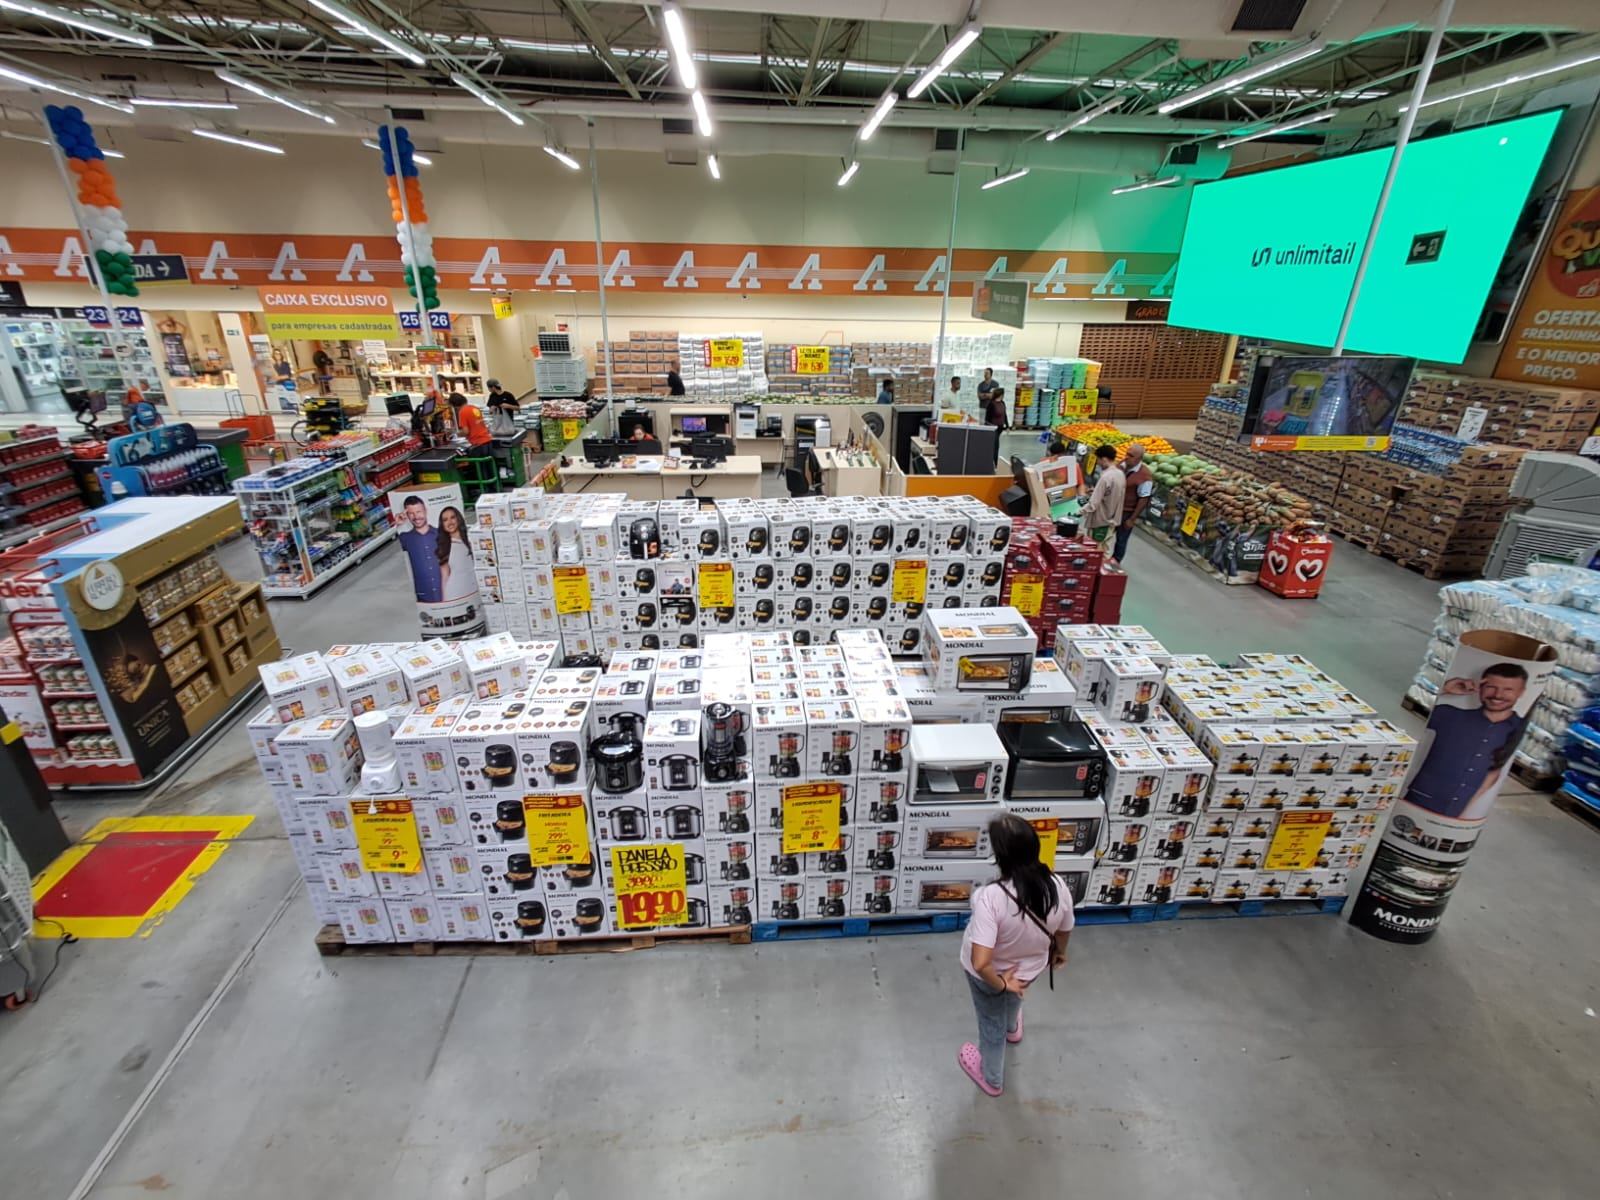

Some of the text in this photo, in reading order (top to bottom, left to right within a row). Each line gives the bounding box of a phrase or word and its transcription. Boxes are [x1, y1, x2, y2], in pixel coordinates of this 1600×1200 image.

[1276, 242, 1356, 265] unlimitail
[264, 294, 388, 307] CAIXA EXCLUSIVO
[86, 308, 106, 322] 23
[120, 310, 139, 322] 24
[402, 314, 419, 326] 25
[431, 314, 448, 327] 26
[272, 322, 392, 332] para empresas cadastradas
[1516, 348, 1600, 366] E O MENOR
[1522, 364, 1578, 382] PREÇO.
[616, 848, 672, 864] PANELA
